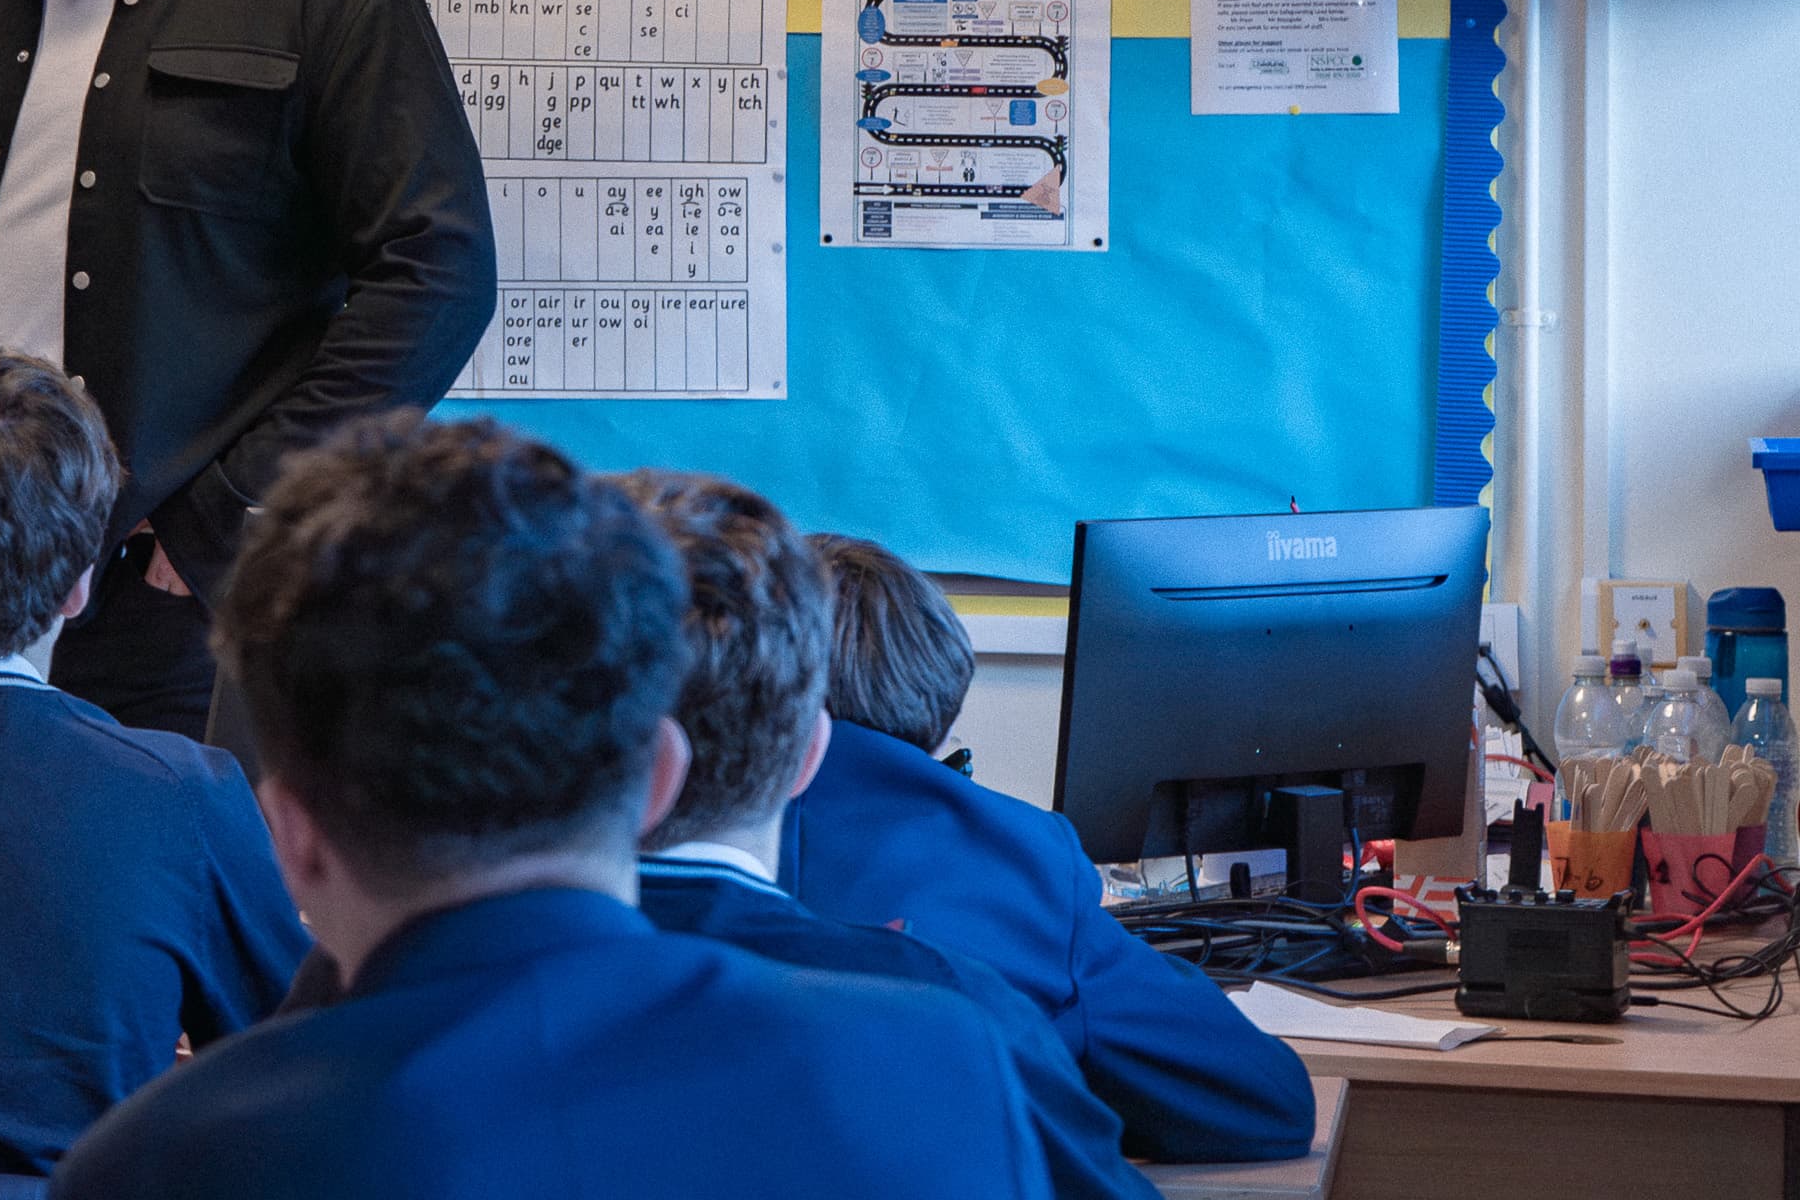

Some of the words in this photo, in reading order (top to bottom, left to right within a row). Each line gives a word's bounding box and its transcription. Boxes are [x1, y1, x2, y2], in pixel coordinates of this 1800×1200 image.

[475, 0, 499, 14] mb
[510, 0, 529, 15] kn
[542, 3, 563, 15] wr
[576, 4, 592, 16] se
[675, 4, 689, 18] ci
[640, 26, 657, 38] se
[574, 45, 591, 56] ce
[490, 74, 500, 89] g
[576, 76, 585, 90] p
[600, 76, 619, 91] qu
[661, 76, 674, 87] w
[740, 74, 760, 88] ch
[484, 95, 505, 110] gg
[570, 97, 591, 112] pp
[632, 96, 645, 109] tt
[655, 94, 680, 109] wh
[738, 96, 762, 110] tch
[542, 117, 561, 133] ge
[537, 135, 562, 155] dge
[538, 187, 547, 197] o
[575, 187, 584, 197] u
[607, 187, 626, 202] ay
[646, 187, 663, 198] ee
[679, 184, 704, 202] igh
[718, 187, 741, 198] ow
[605, 205, 629, 217] a-e
[682, 204, 701, 218] i-e
[718, 205, 742, 217] o-e
[610, 223, 625, 235] ai
[646, 225, 664, 235] ea
[686, 222, 699, 236] ie
[720, 225, 740, 236] oa
[510, 298, 527, 309] or
[538, 296, 560, 309] air
[574, 296, 585, 309] ir
[600, 299, 620, 309] ou
[631, 299, 650, 314] oy
[661, 296, 681, 309] ire
[689, 299, 716, 310] ear
[721, 299, 745, 310] ure
[505, 317, 532, 328] oor
[537, 317, 562, 328] are
[572, 317, 589, 328] ur
[599, 318, 622, 328] ow
[634, 315, 648, 328] oi
[507, 336, 532, 347] ore
[572, 336, 588, 347] er
[507, 355, 530, 366] aw
[509, 374, 528, 385] au
[1266, 530, 1337, 560] iiyama
